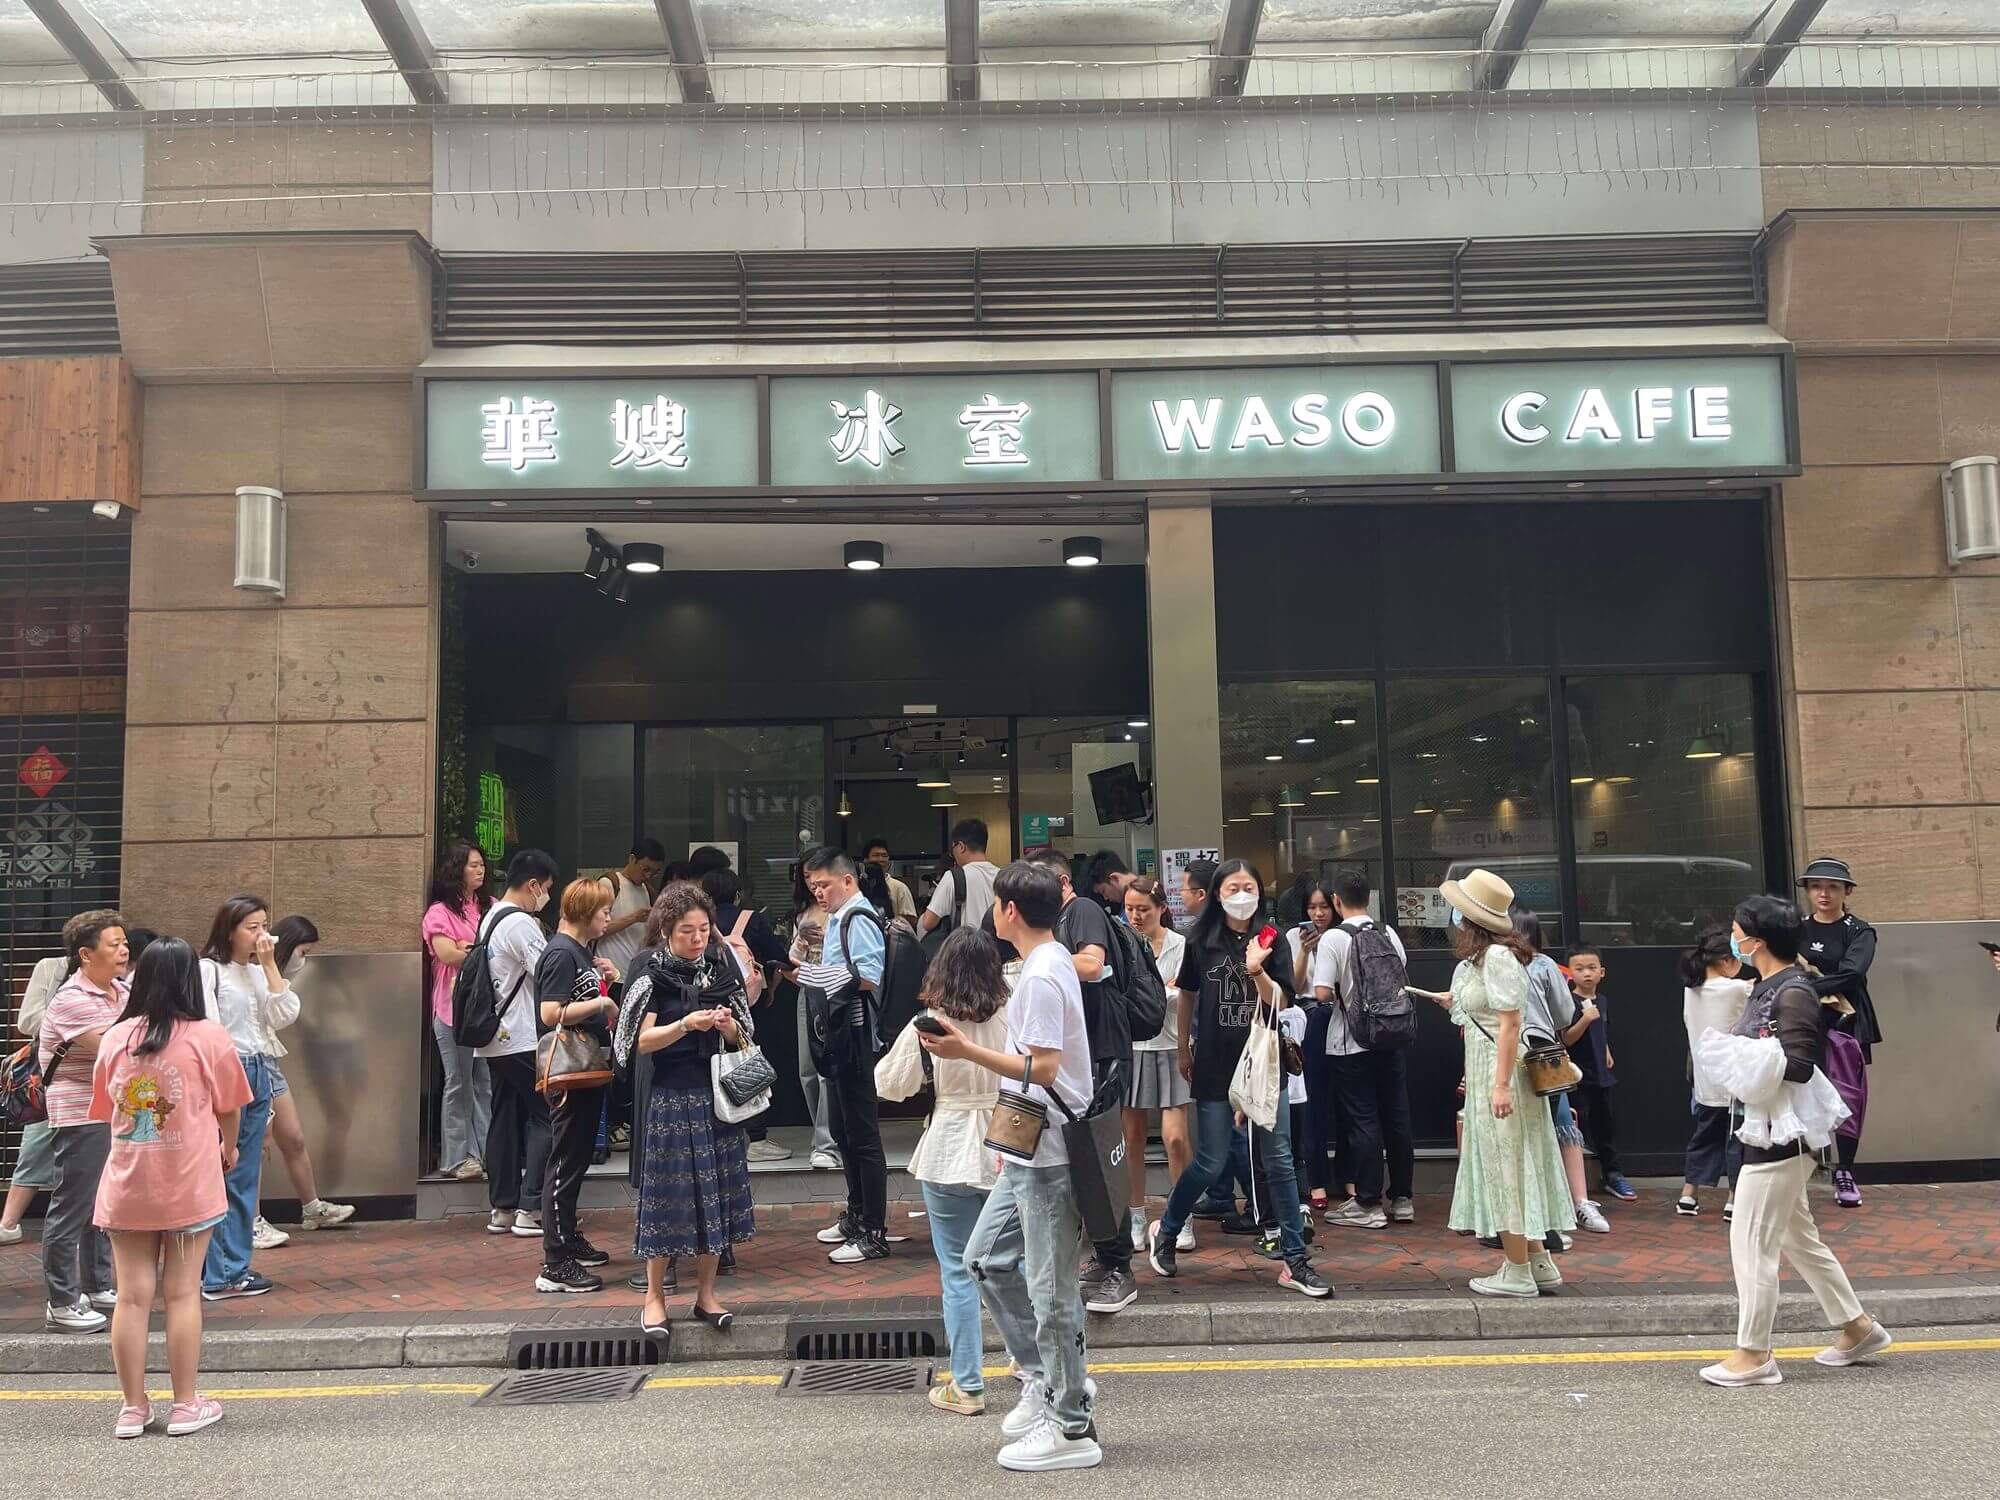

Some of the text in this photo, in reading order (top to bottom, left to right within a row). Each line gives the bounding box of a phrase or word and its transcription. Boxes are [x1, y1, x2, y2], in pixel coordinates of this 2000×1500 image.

[481, 389, 1030, 471] 華嫂 冰室
[1151, 385, 1734, 452] WASO CAFE
[6, 878, 33, 889] NAN
